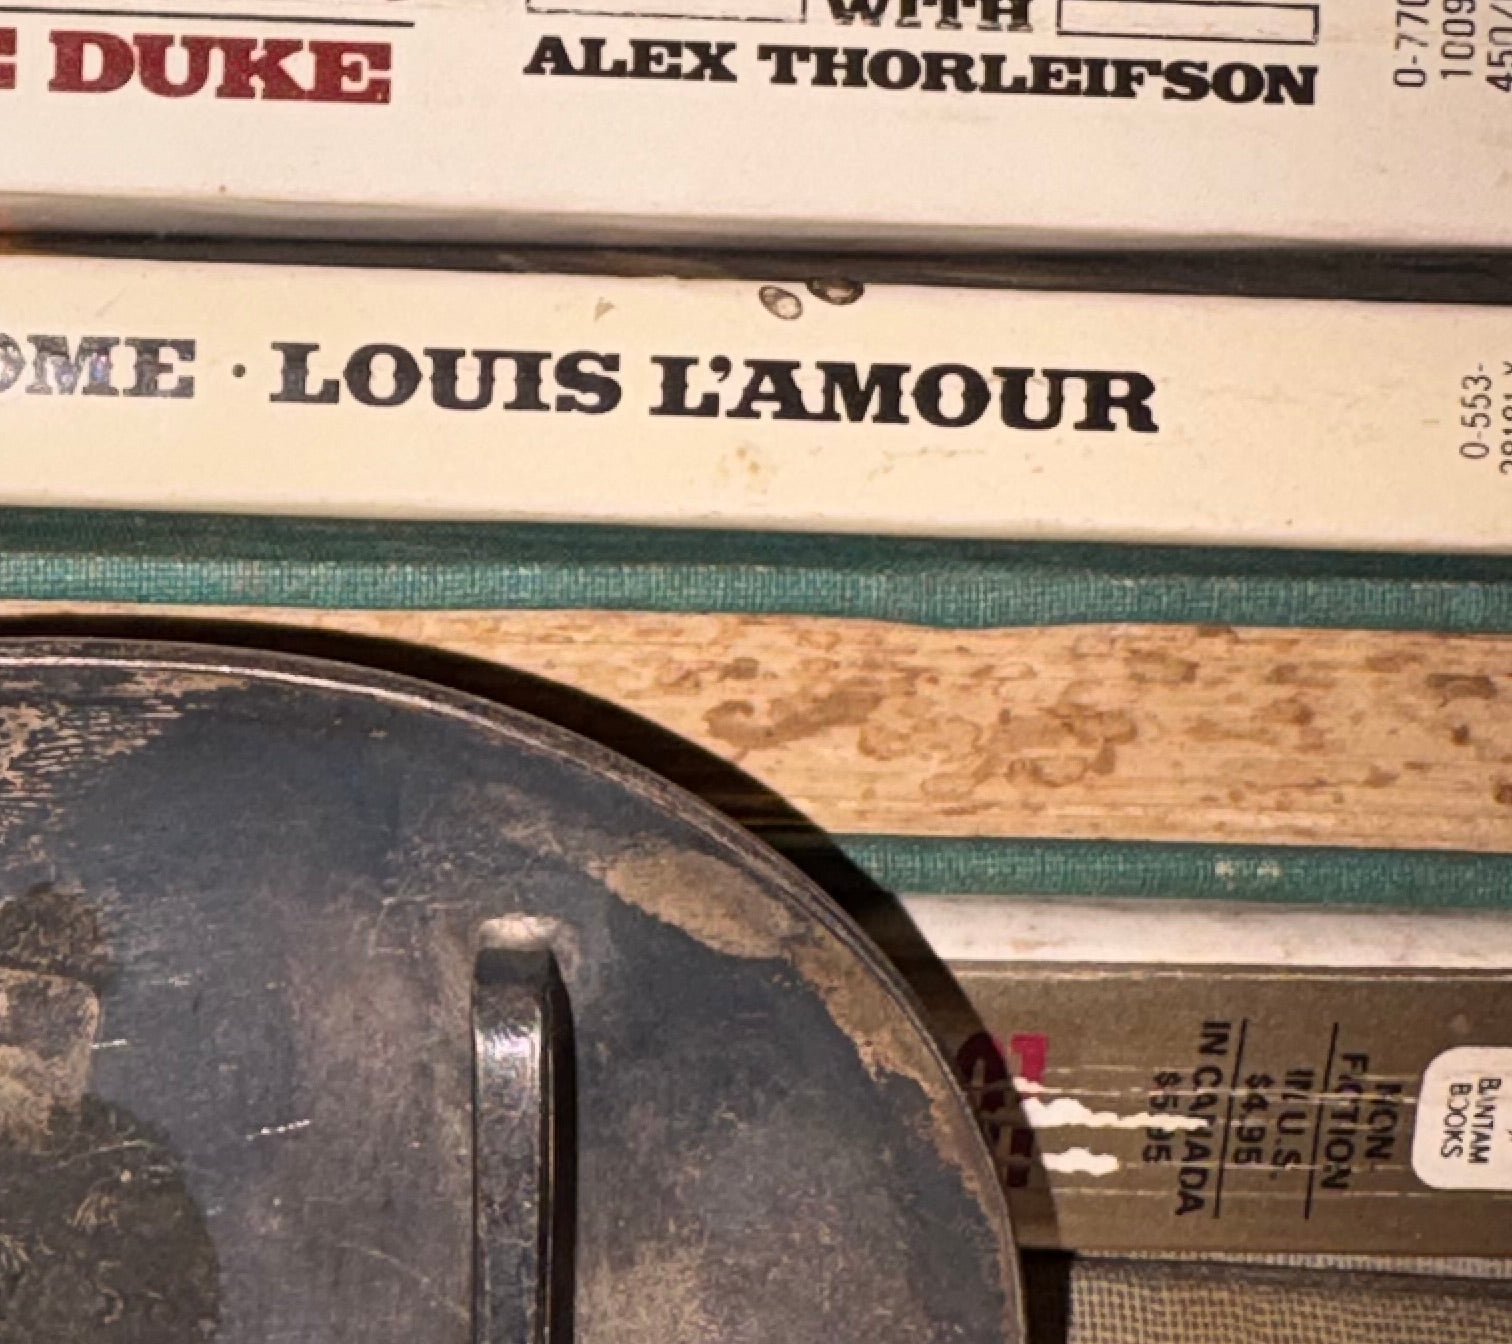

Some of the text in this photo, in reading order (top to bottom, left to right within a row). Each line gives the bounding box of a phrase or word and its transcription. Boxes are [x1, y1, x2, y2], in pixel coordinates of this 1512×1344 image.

[48, 29, 392, 105] DUKE
[523, 35, 1319, 106] ALEX THORLEIFSON
[269, 341, 622, 414] LOUIS
[649, 354, 1159, 434] L'AMOUR
[1458, 362, 1492, 459] 0-553-
[1175, 1021, 1232, 1216] IN CANADA
[1280, 1068, 1315, 1101] IN
[1440, 1082, 1473, 1158] BOOKS
